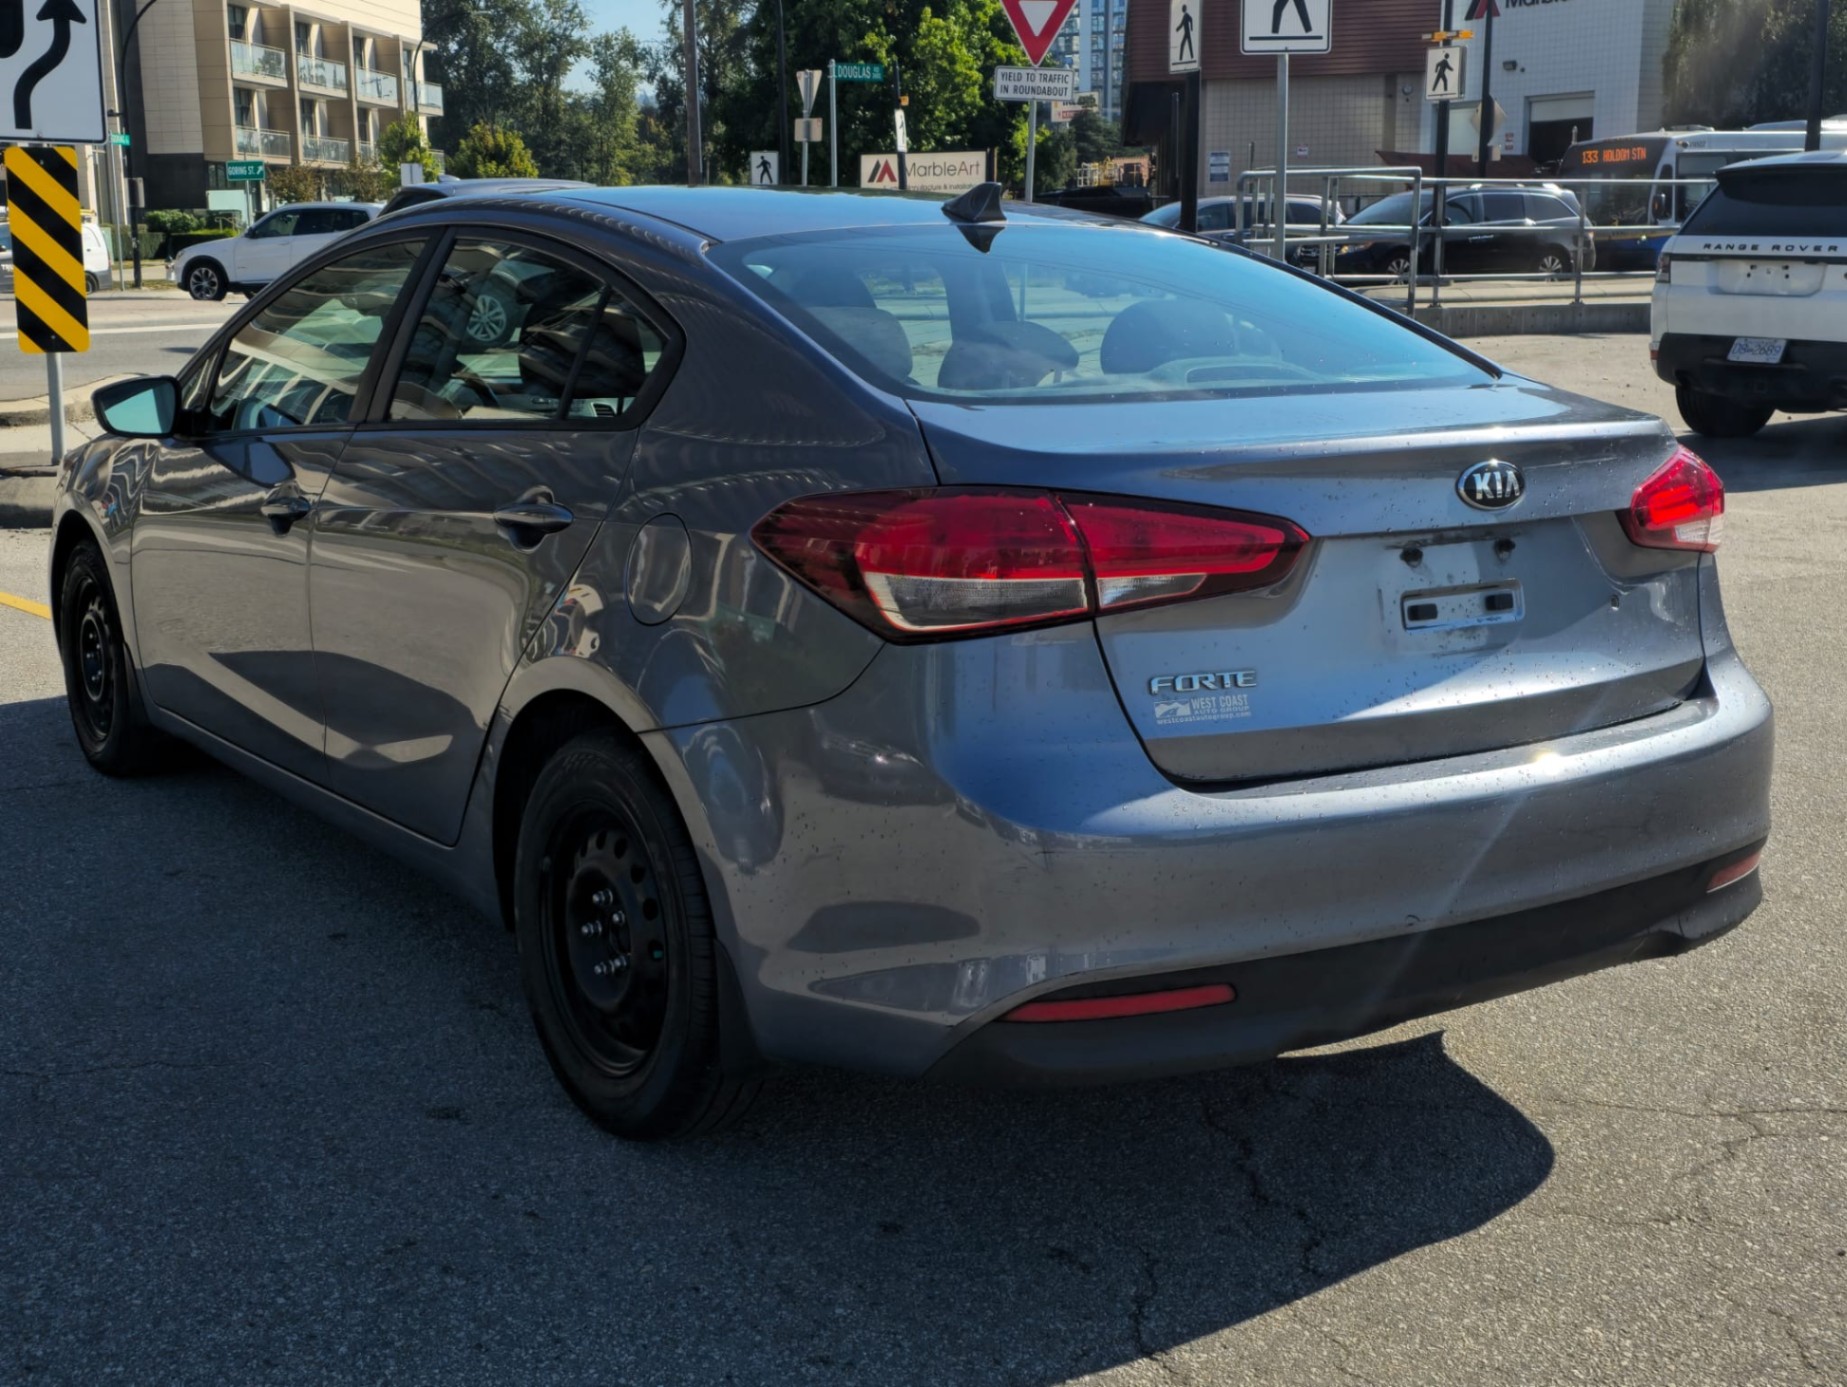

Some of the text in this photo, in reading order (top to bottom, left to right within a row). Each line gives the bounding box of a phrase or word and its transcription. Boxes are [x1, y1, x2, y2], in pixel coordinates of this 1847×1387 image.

[837, 65, 871, 79] DOUGLAS
[1000, 72, 1069, 84] YIELD TO TRAFFIC
[1000, 85, 1069, 97] IN ROUNDABOUT
[1582, 147, 1647, 164] 133 HOLDOM STN
[228, 166, 247, 176] GORING
[904, 160, 981, 178] MarbleArt
[1703, 243, 1839, 253] RANGE ROVER
[1472, 469, 1521, 500] KIA
[1149, 670, 1257, 695] FORTE
[1191, 694, 1248, 709] WEST COAST
